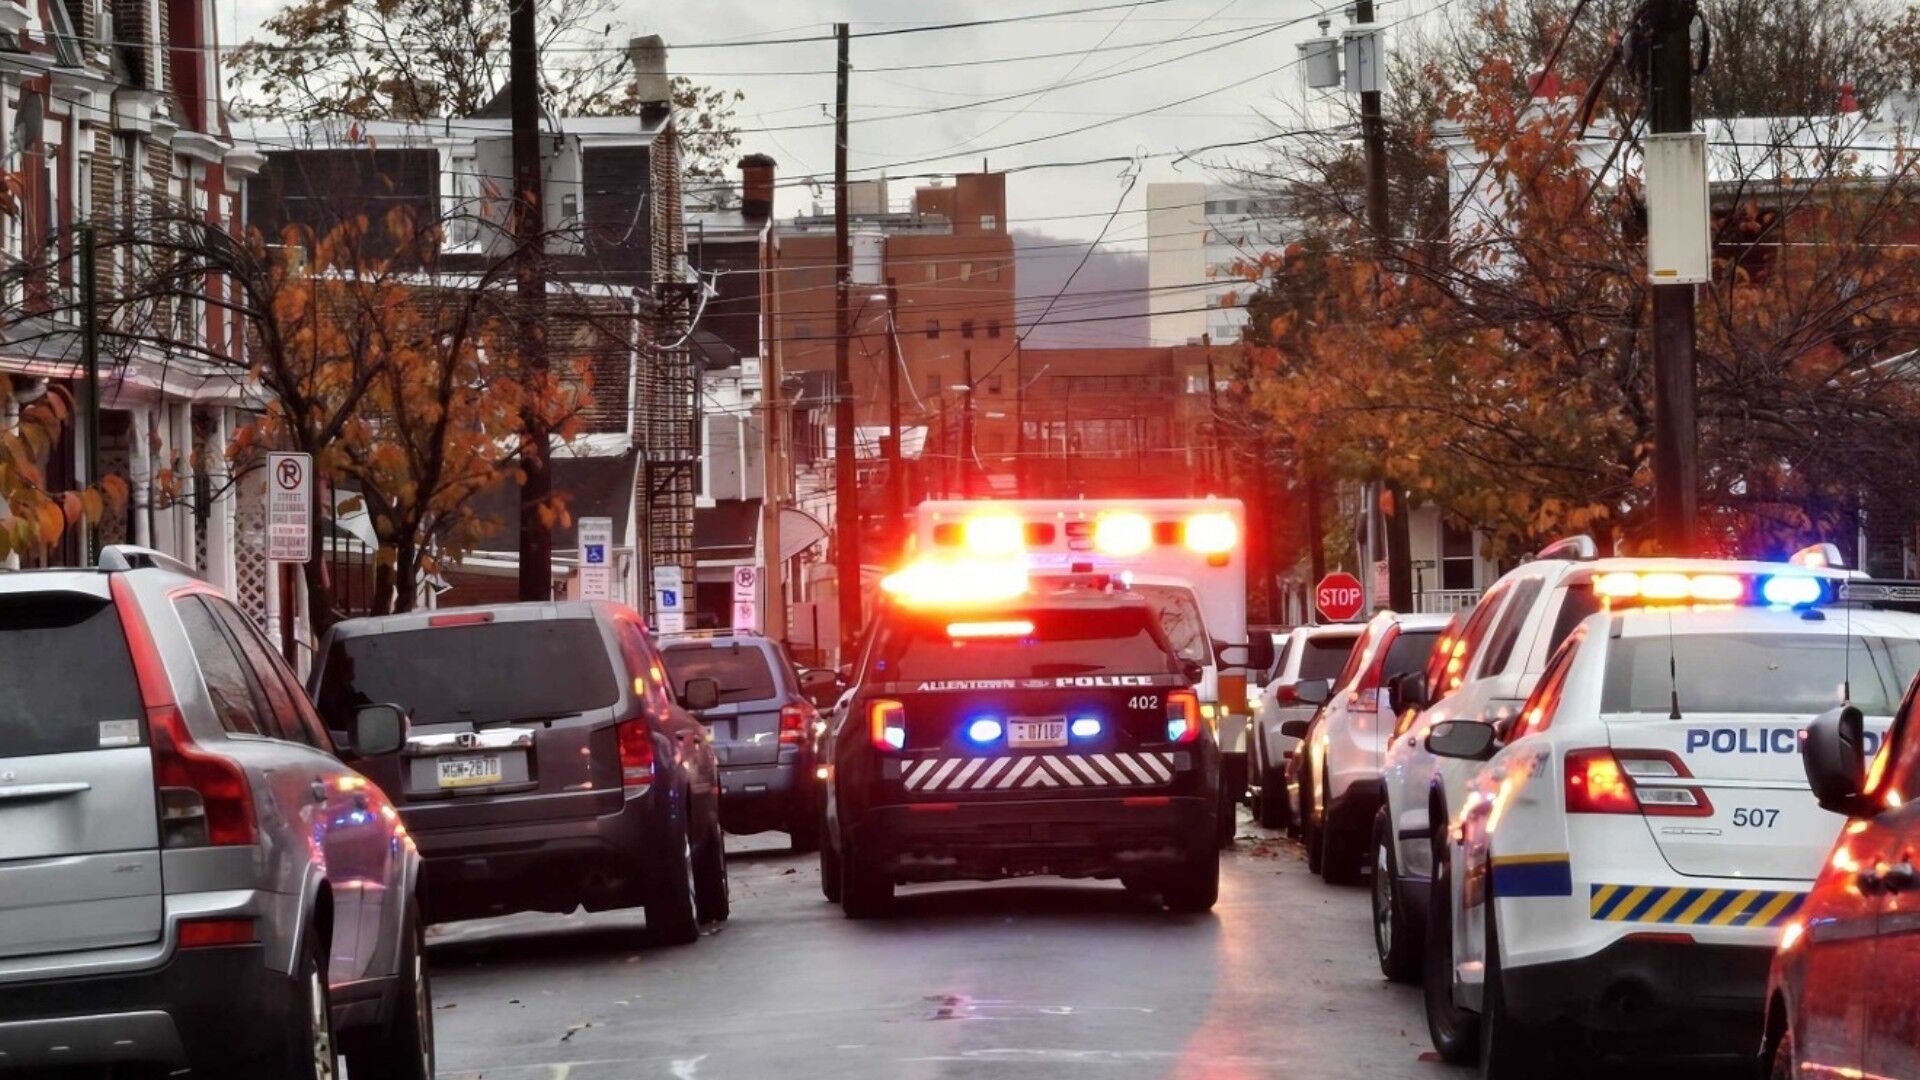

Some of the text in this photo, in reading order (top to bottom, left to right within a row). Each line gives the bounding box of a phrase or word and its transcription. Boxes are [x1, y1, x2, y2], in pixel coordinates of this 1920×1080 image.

[1320, 588, 1361, 606] STOP
[917, 676, 1154, 691] ALLENTOWN POLICE
[1128, 695, 1159, 710] 402
[1732, 807, 1780, 828] 507
